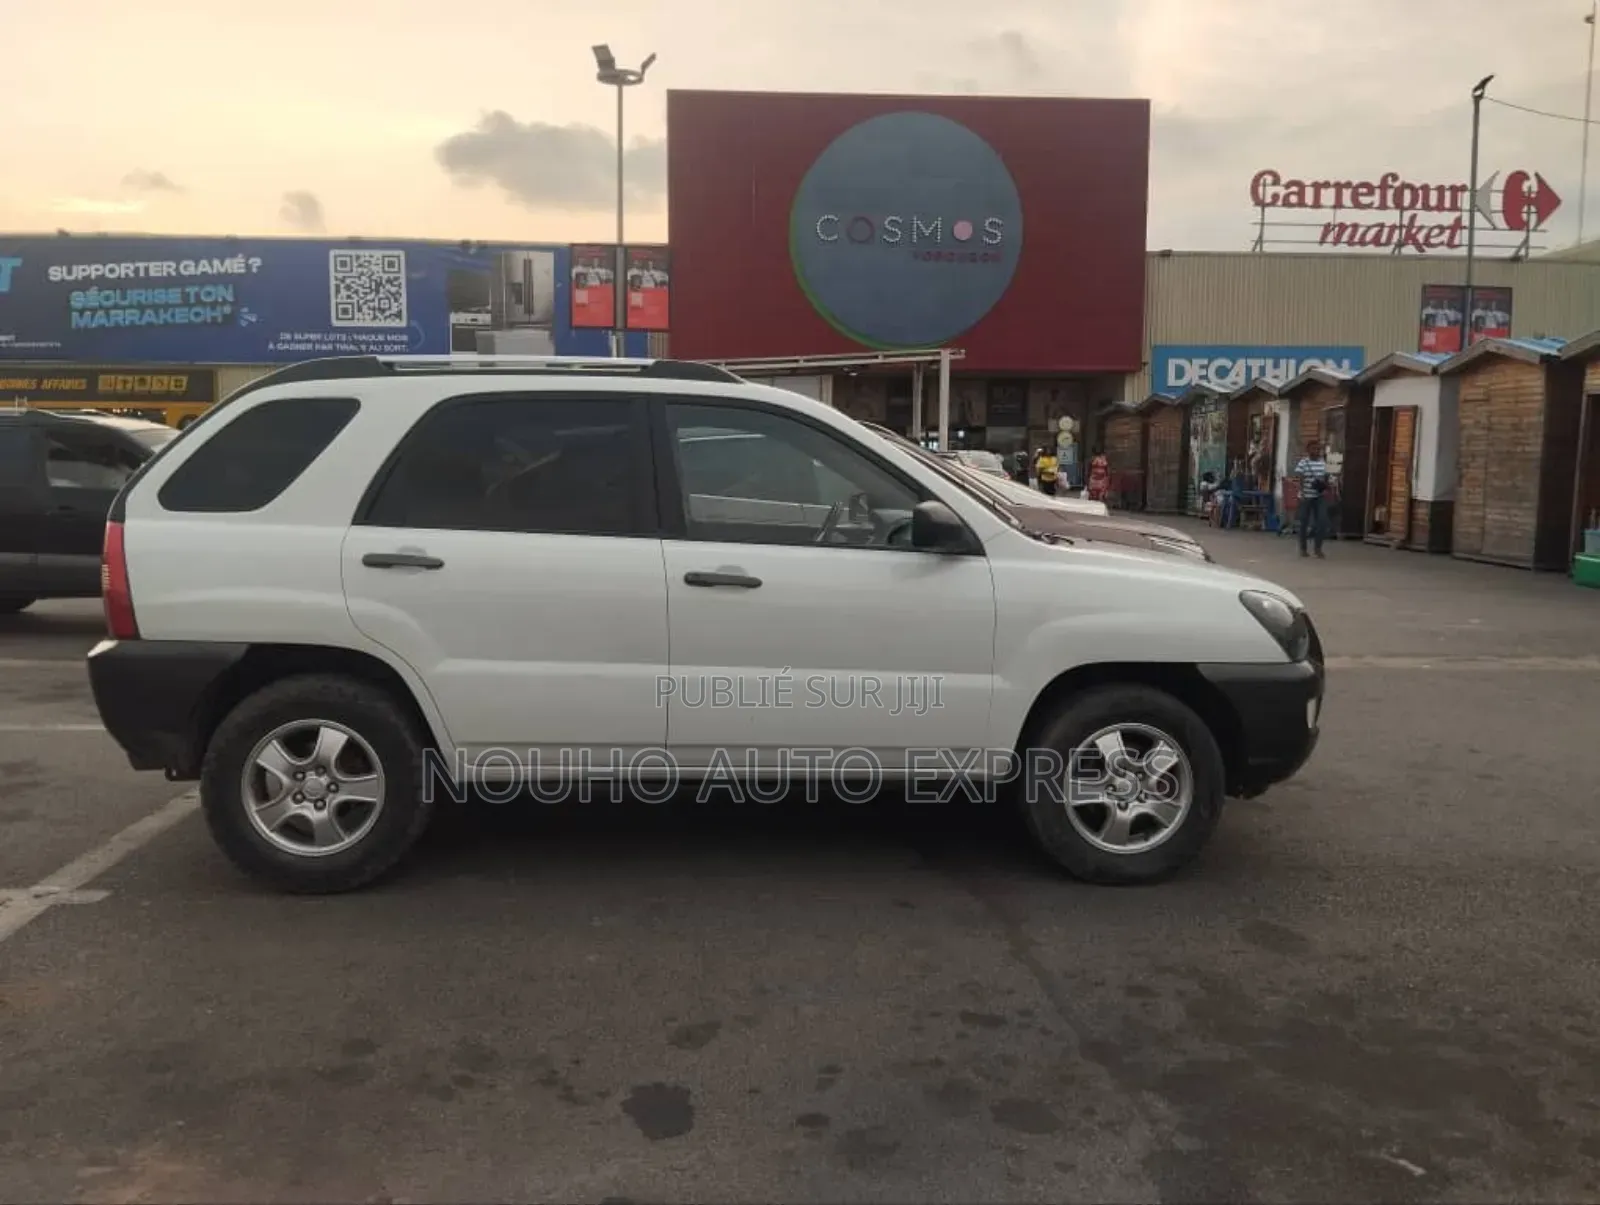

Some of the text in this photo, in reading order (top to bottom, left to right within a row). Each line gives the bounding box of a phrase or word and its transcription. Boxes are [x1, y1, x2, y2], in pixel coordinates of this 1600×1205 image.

[1250, 170, 1468, 211] Carrefour
[816, 214, 1004, 244] COSMOS
[1319, 213, 1466, 253] market
[48, 260, 177, 281] SUPPORTER
[70, 284, 235, 309] SÉCURISE TON
